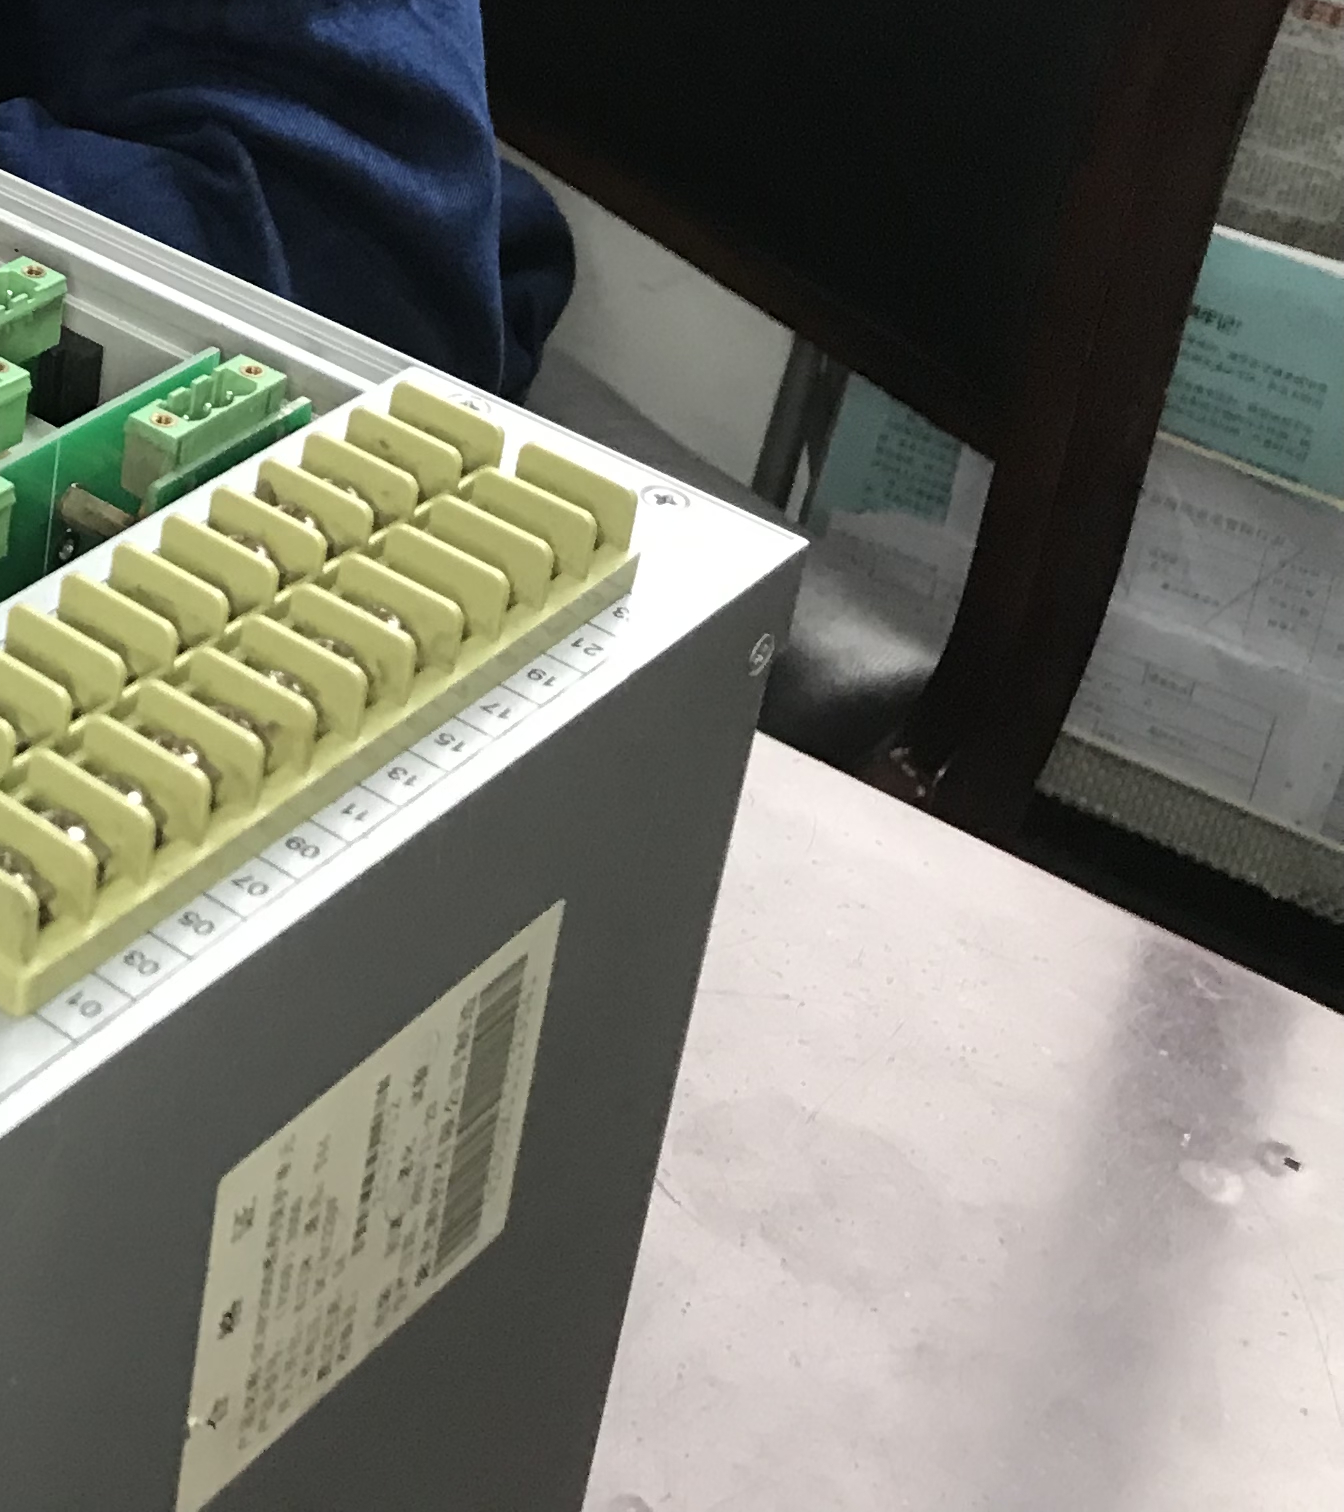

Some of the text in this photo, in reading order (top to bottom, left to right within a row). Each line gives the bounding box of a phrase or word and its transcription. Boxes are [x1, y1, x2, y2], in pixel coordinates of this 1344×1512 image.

[570, 637, 605, 657] 21
[527, 668, 557, 688] 19
[479, 702, 513, 720] 17
[433, 732, 466, 753] 15
[387, 766, 418, 788] 13
[285, 836, 321, 859] 09
[230, 875, 269, 897] 07
[177, 911, 216, 936] 05
[123, 949, 160, 977] 03
[67, 990, 103, 1019] 01
